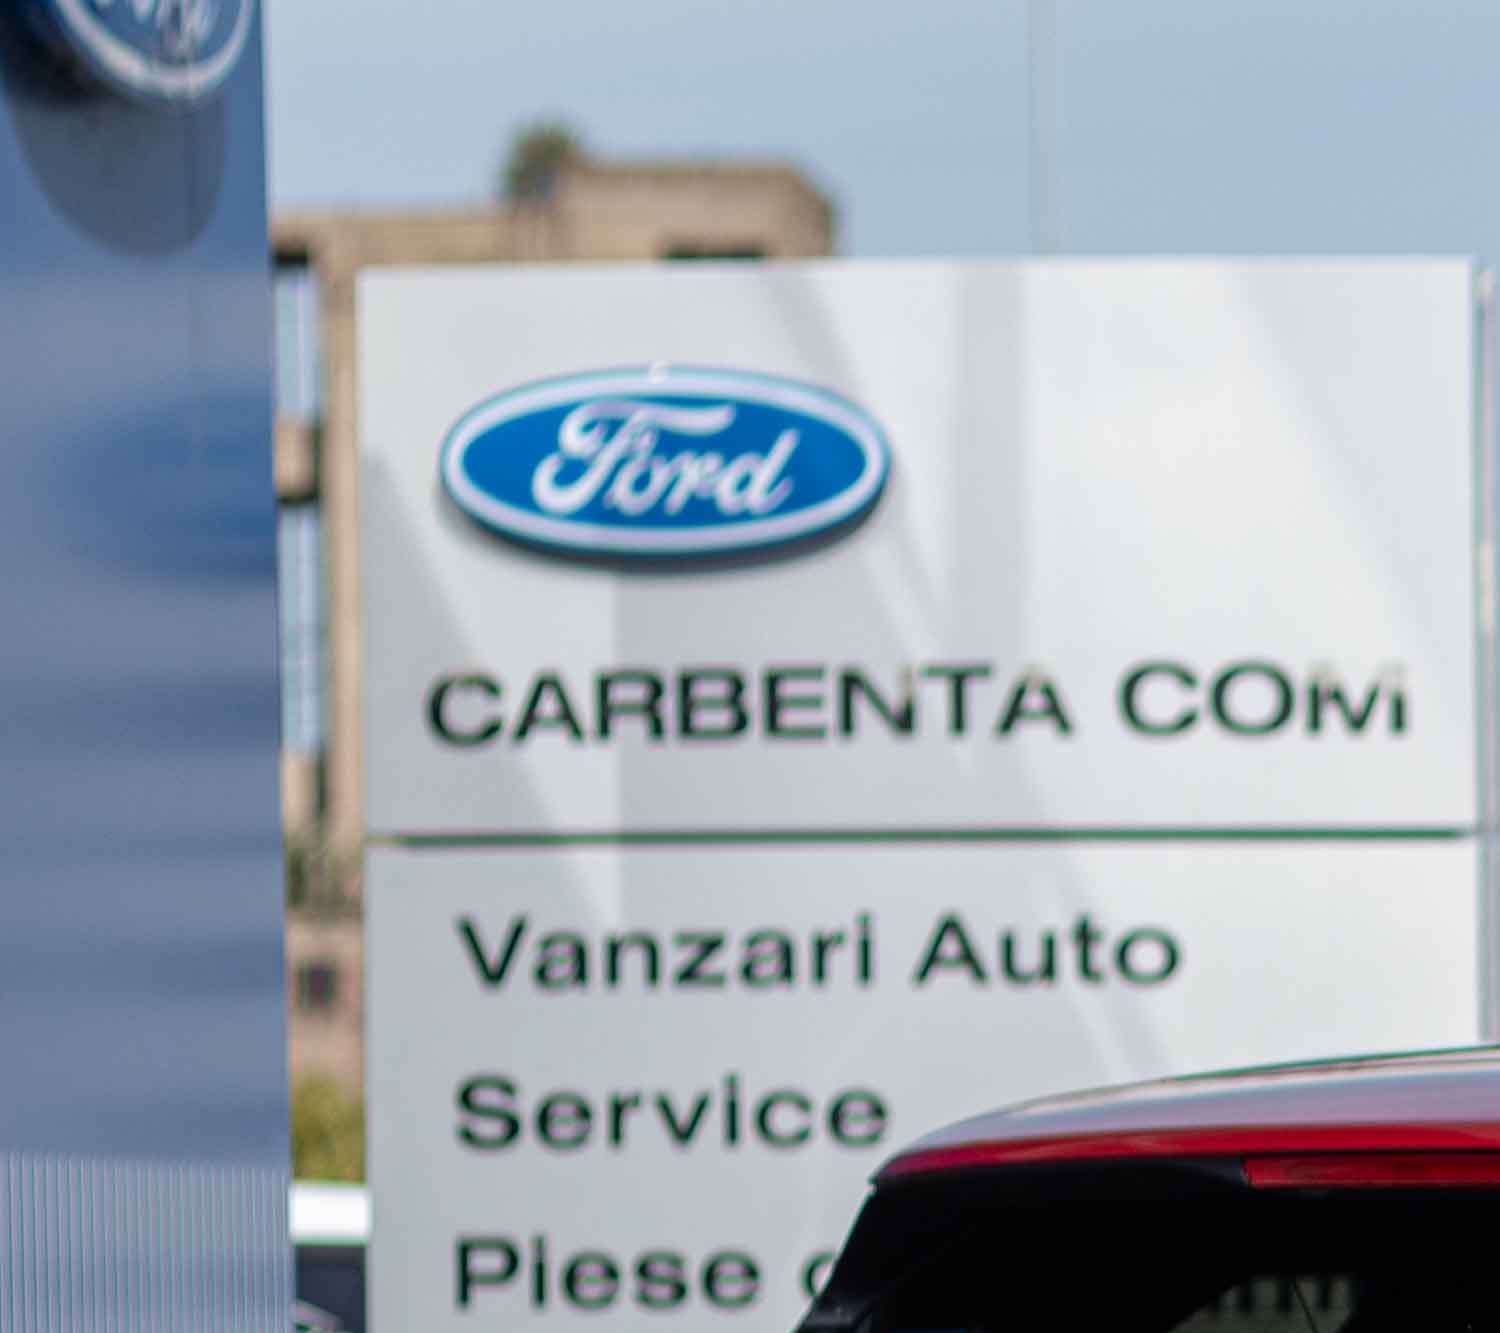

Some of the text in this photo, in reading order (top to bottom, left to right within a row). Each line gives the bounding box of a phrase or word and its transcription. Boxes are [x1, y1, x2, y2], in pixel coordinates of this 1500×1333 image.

[422, 661, 1411, 751] CARBENTA COM
[455, 913, 1182, 992] Vanzari Auto
[453, 1073, 891, 1153] Service
[452, 1232, 763, 1313] Piese
